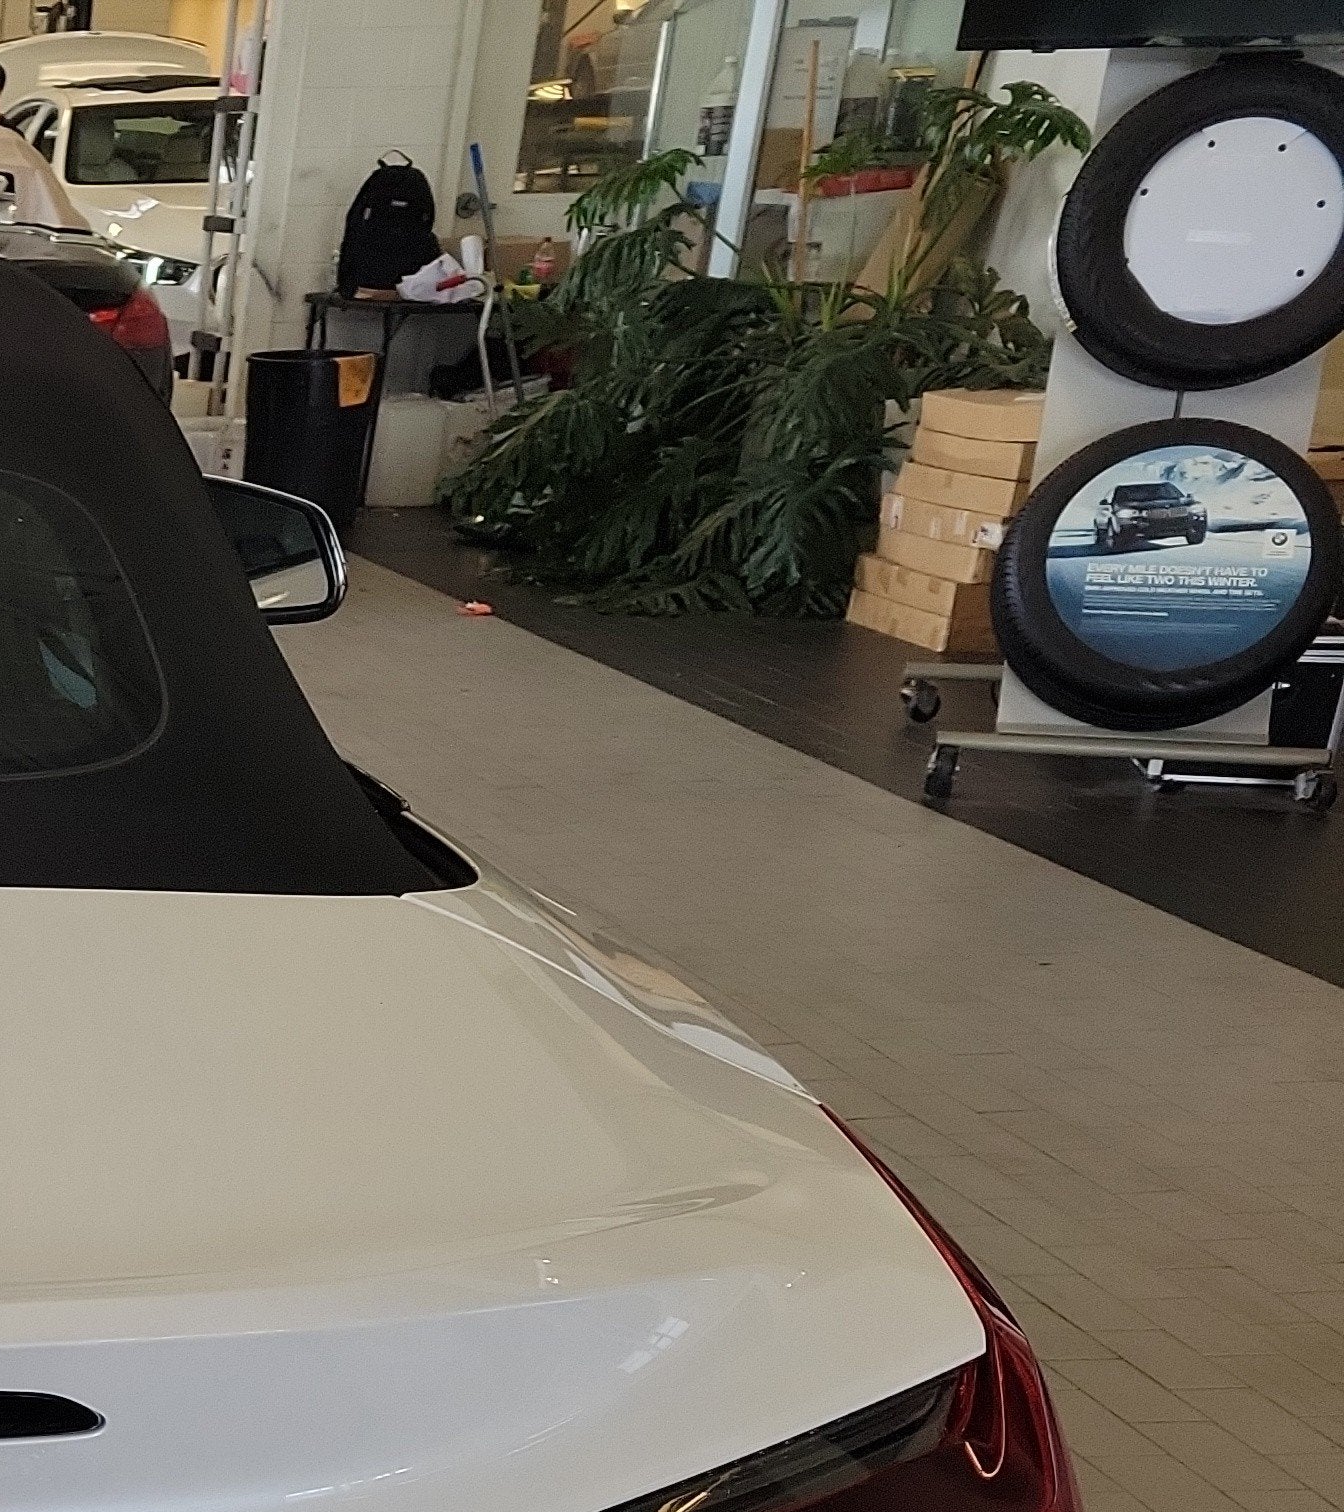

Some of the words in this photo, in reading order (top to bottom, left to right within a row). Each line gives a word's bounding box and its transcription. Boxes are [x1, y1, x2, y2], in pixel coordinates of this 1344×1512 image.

[1086, 562, 1126, 573] EVERY
[1129, 564, 1157, 574] MILE
[1159, 565, 1212, 576] DOESN'T
[1214, 566, 1248, 576] HAVE
[1251, 567, 1268, 577] TO
[1085, 573, 1115, 583] FEEL
[1117, 574, 1144, 584] LIKE
[1146, 575, 1175, 585] TWO
[1178, 576, 1205, 586] THIS
